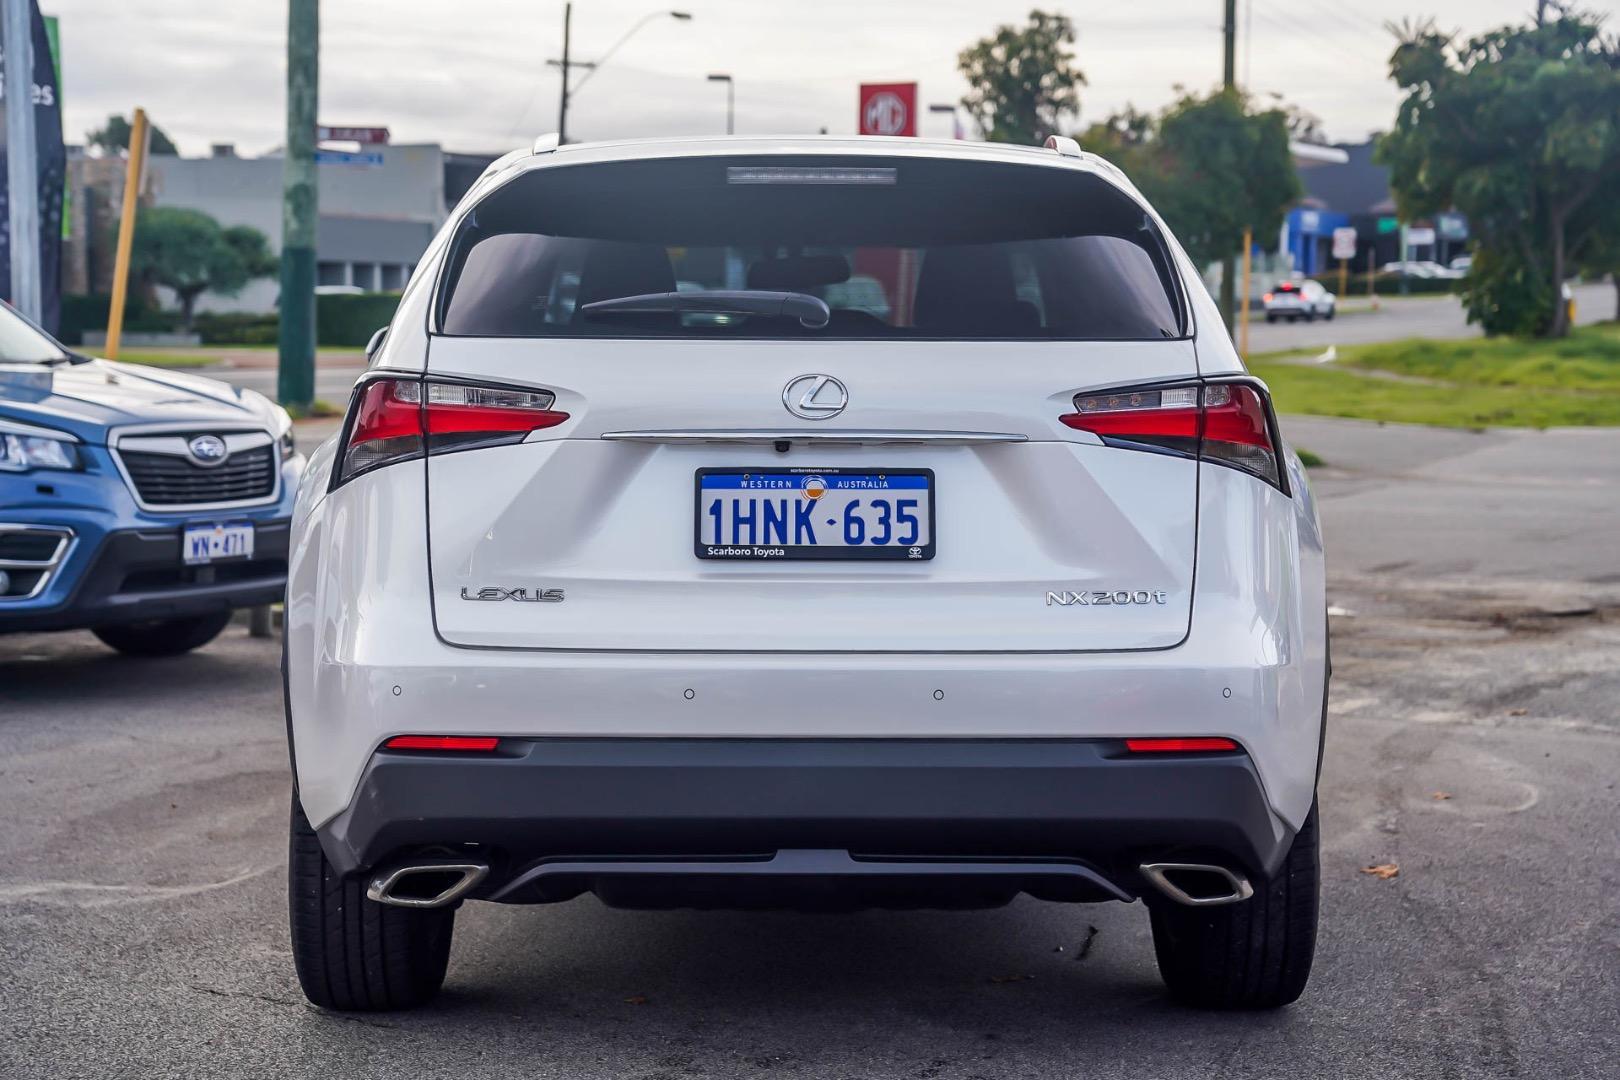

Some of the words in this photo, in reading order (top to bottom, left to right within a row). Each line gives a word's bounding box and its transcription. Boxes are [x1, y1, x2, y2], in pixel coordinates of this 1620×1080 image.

[740, 480, 792, 489] WESTERN
[837, 480, 889, 489] AUSTRALIA
[707, 547, 751, 556] Scarboro
[753, 547, 785, 557] Toyota
[460, 586, 565, 603] LEXUS
